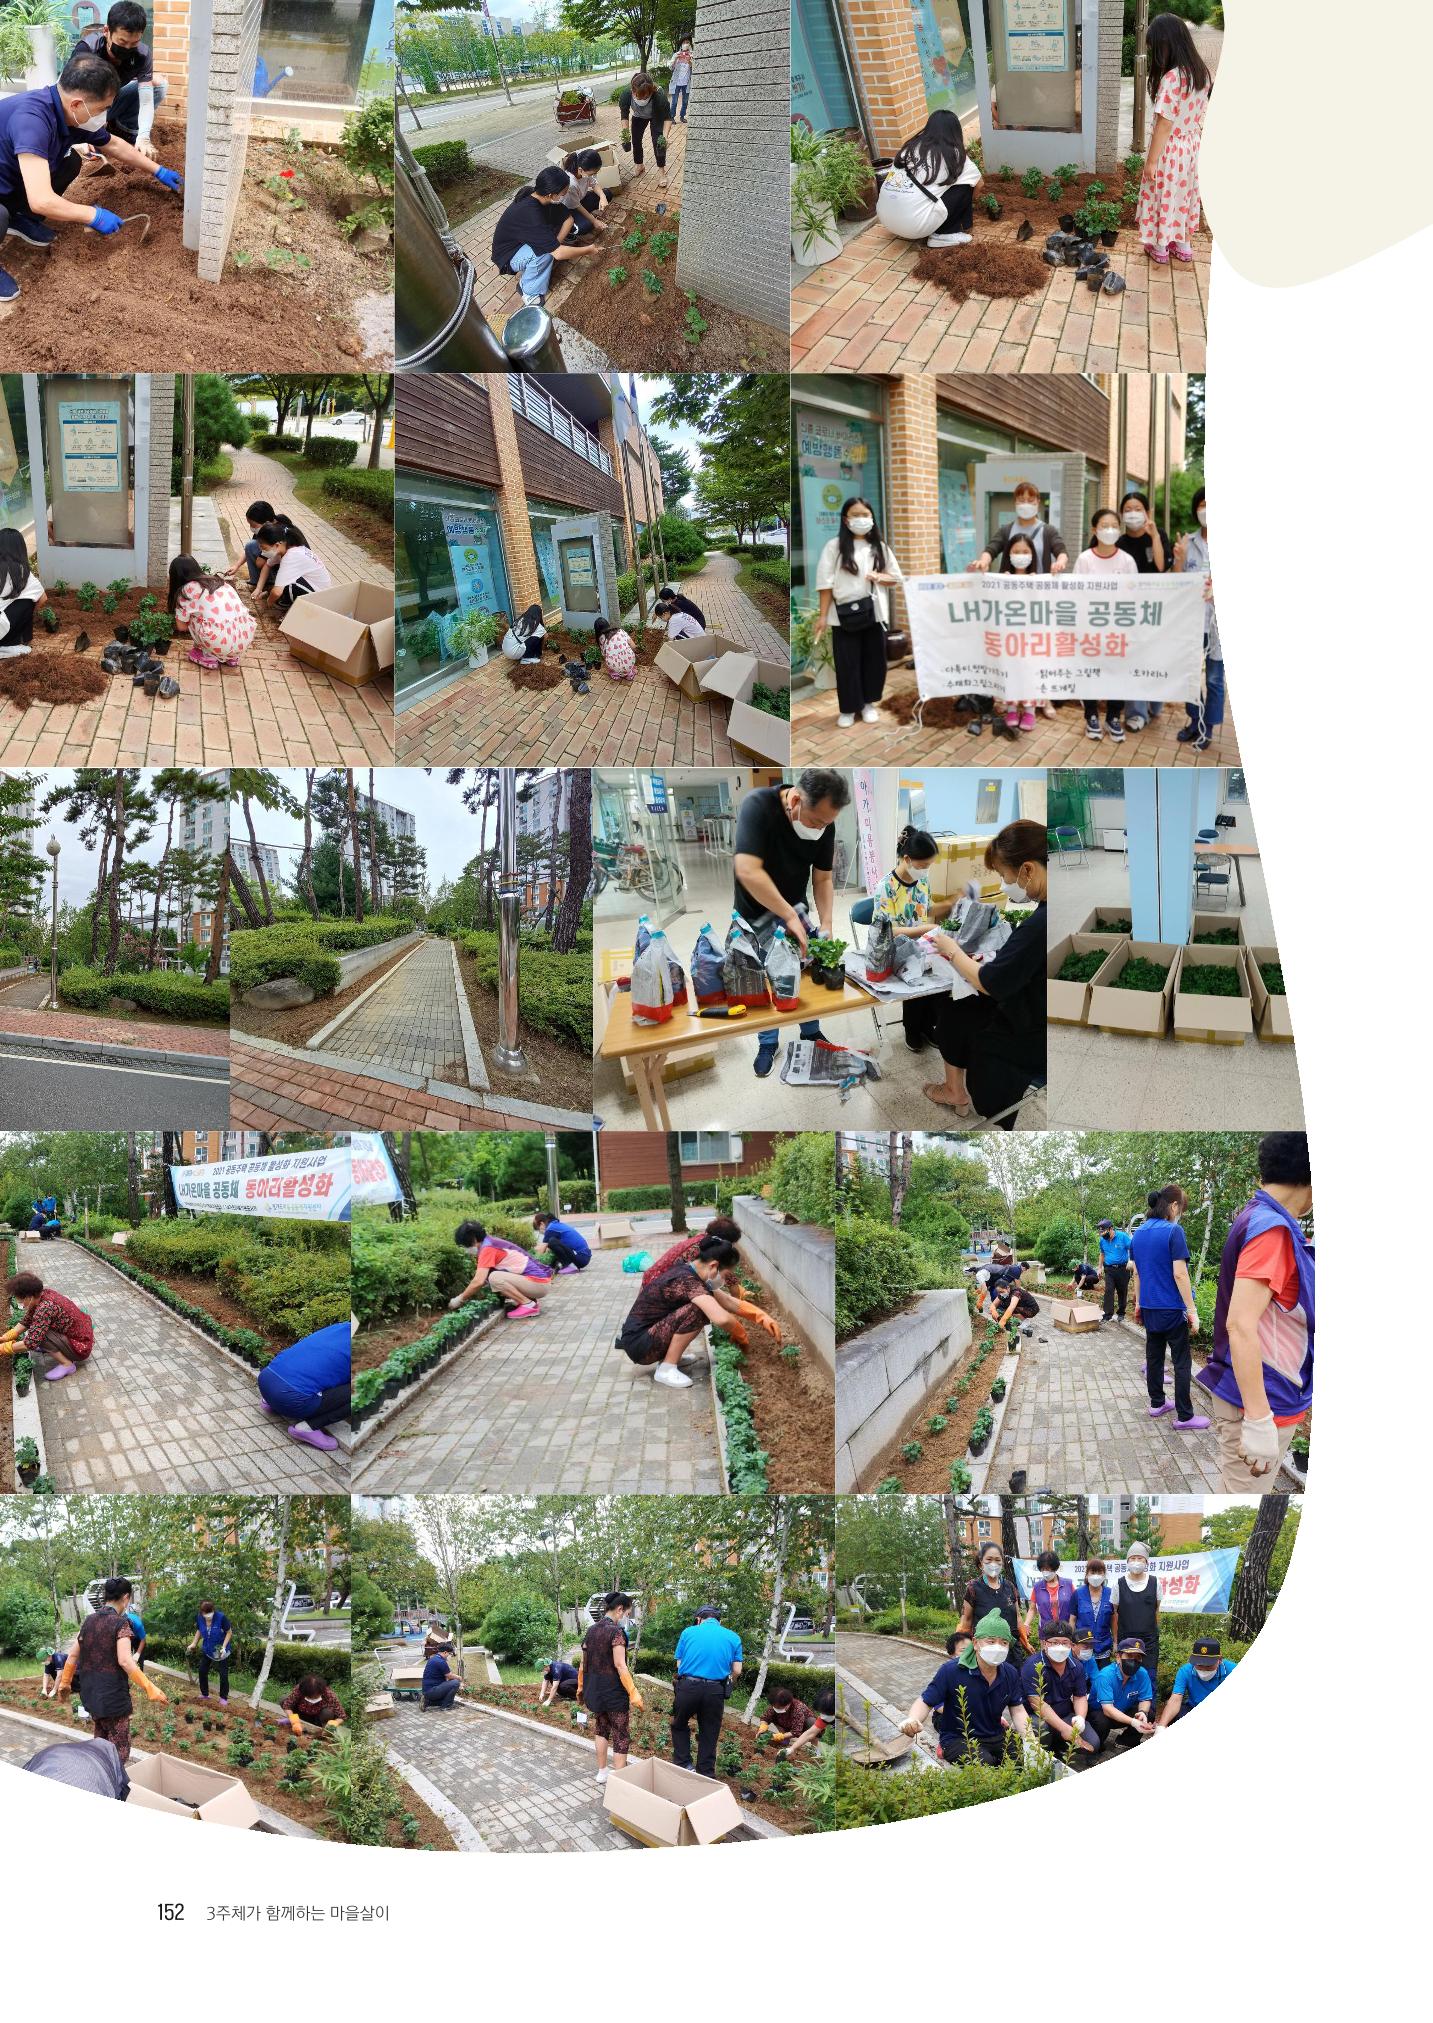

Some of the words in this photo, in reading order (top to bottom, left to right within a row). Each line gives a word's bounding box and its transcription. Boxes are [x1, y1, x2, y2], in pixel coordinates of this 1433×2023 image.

[982, 581, 1001, 589] 2021
[1003, 581, 1034, 590] 공동주택
[1036, 582, 1059, 590] 공동체
[1061, 582, 1085, 591] 활성화
[1087, 581, 1118, 591] 지원사업
[948, 600, 1078, 627] LH가온마을
[1088, 600, 1163, 627] 공동체
[984, 632, 1129, 658] 동아리활성화
[1132, 669, 1169, 679] 오카리나
[212, 1167, 226, 1176] 2021
[226, 1163, 248, 1175] 공동주택
[249, 1161, 268, 1173] 공동체
[268, 1158, 291, 1172] 활성화
[292, 1155, 327, 1170] 지원사업
[212, 1180, 240, 1199] 공동체
[245, 1173, 333, 1200] 동아리활성화
[1159, 1559, 1190, 1571] 지원사업
